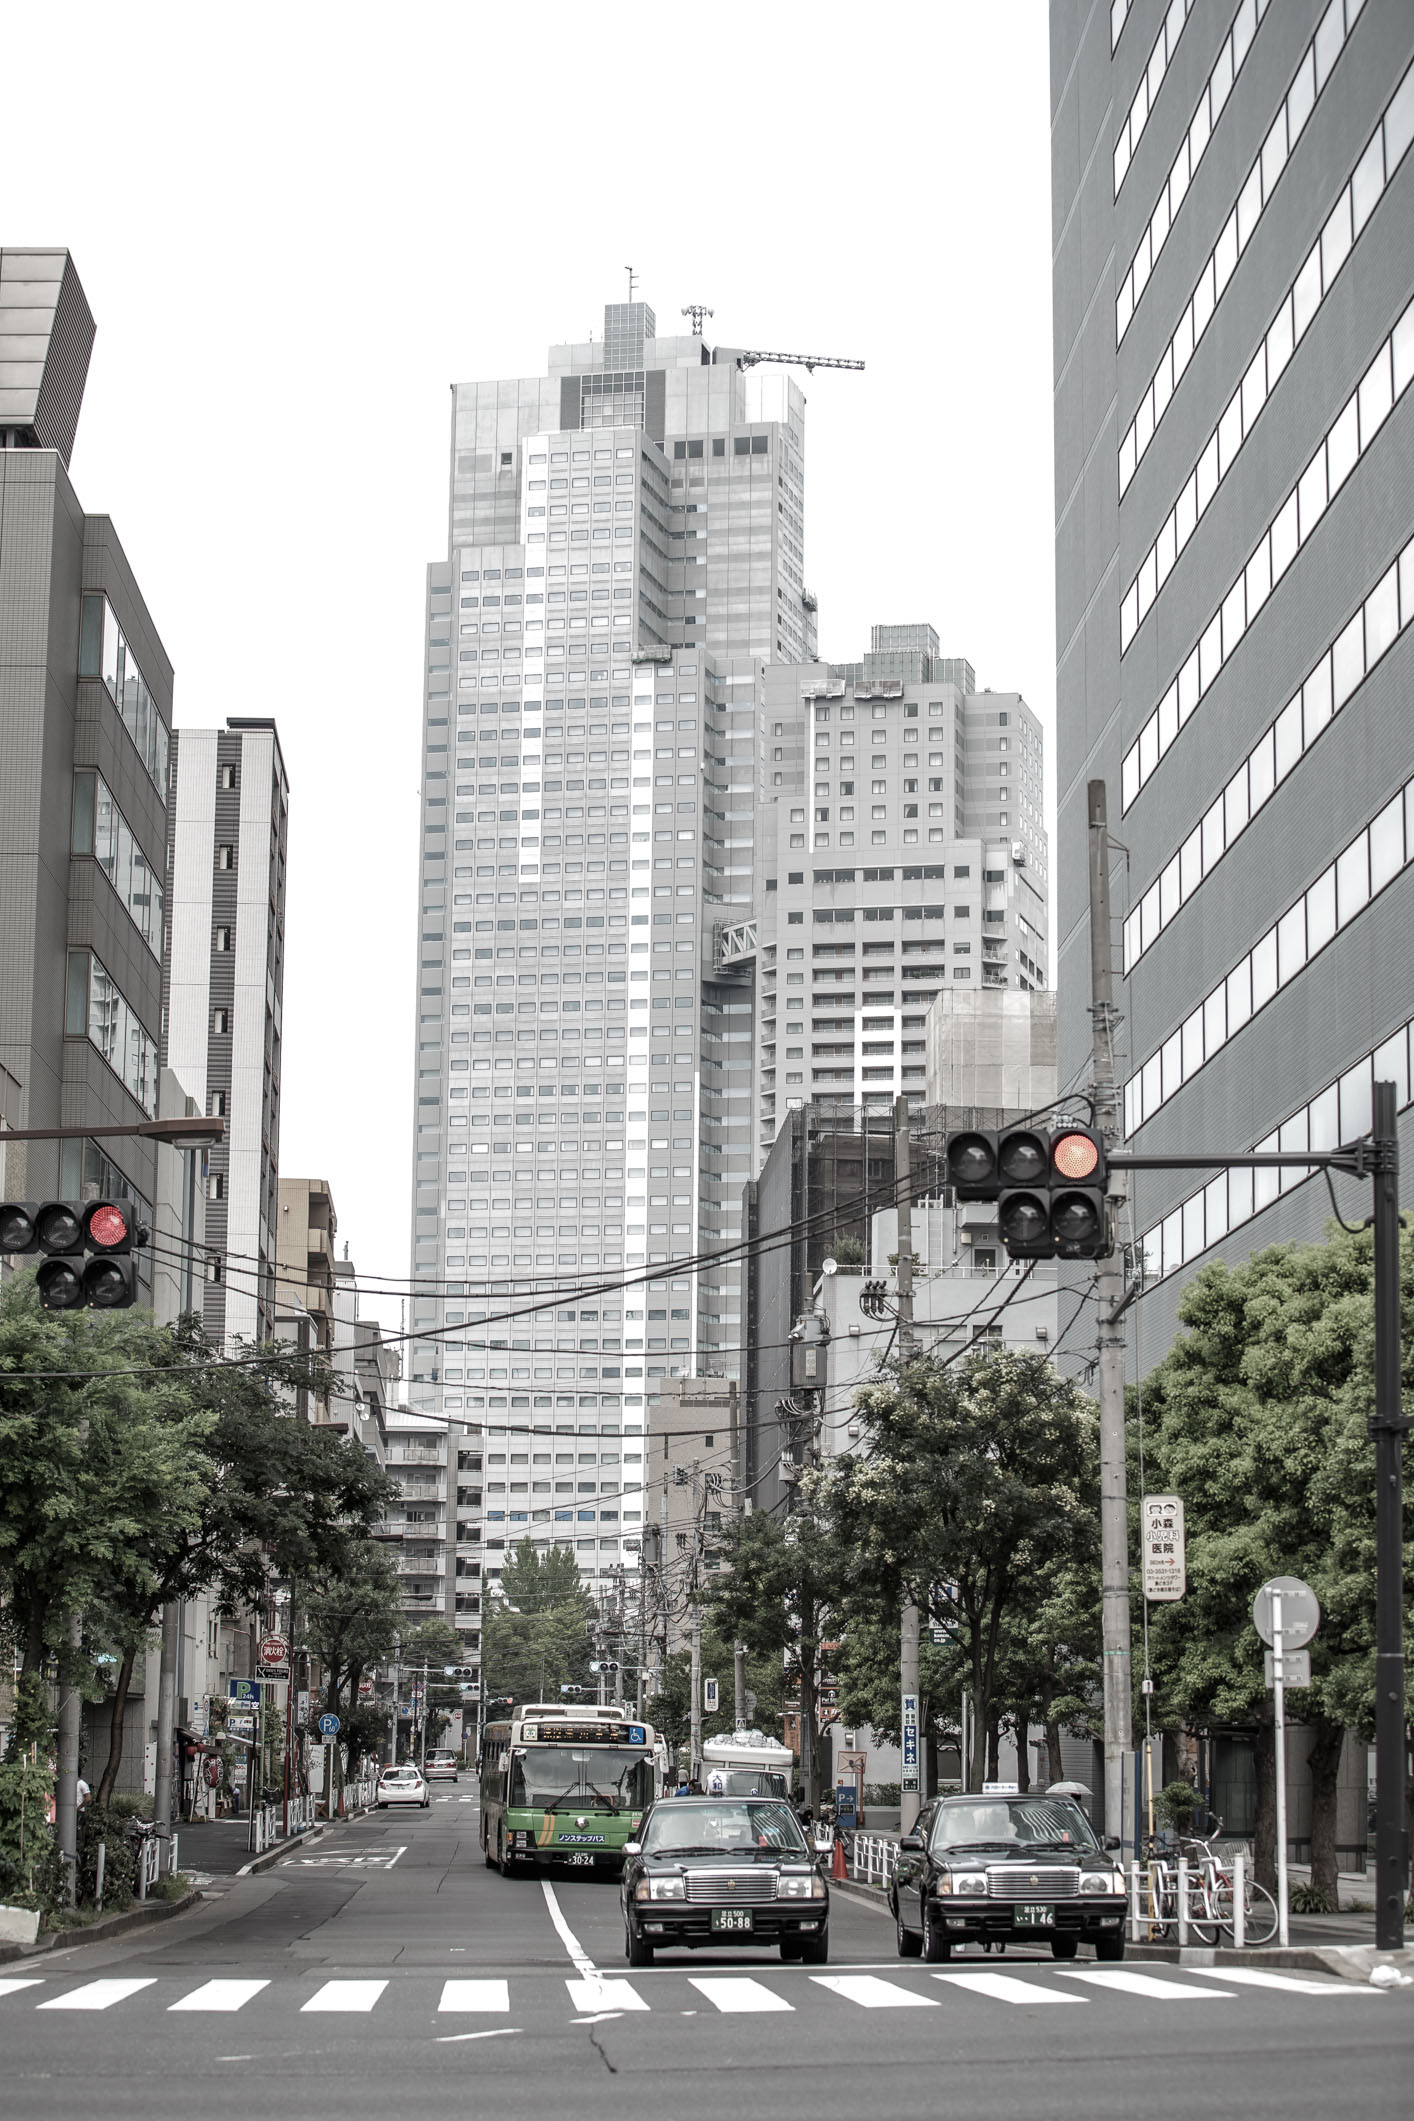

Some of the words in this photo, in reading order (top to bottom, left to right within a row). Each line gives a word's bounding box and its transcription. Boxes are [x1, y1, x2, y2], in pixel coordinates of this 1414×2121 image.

[1151, 1518, 1174, 1529] 小森
[1146, 1530, 1179, 1541] 小児科
[1152, 1543, 1174, 1554] 医院
[263, 1646, 284, 1656] 消火栓
[236, 1681, 251, 1699] P
[323, 1719, 332, 1732] P
[905, 1727, 915, 1763] セキネ
[712, 1775, 722, 1790] 大和
[838, 1793, 845, 1802] P
[559, 1834, 605, 1842] ノンステップバス
[572, 1855, 593, 1865] 30-24
[720, 1917, 750, 1929] 50-88
